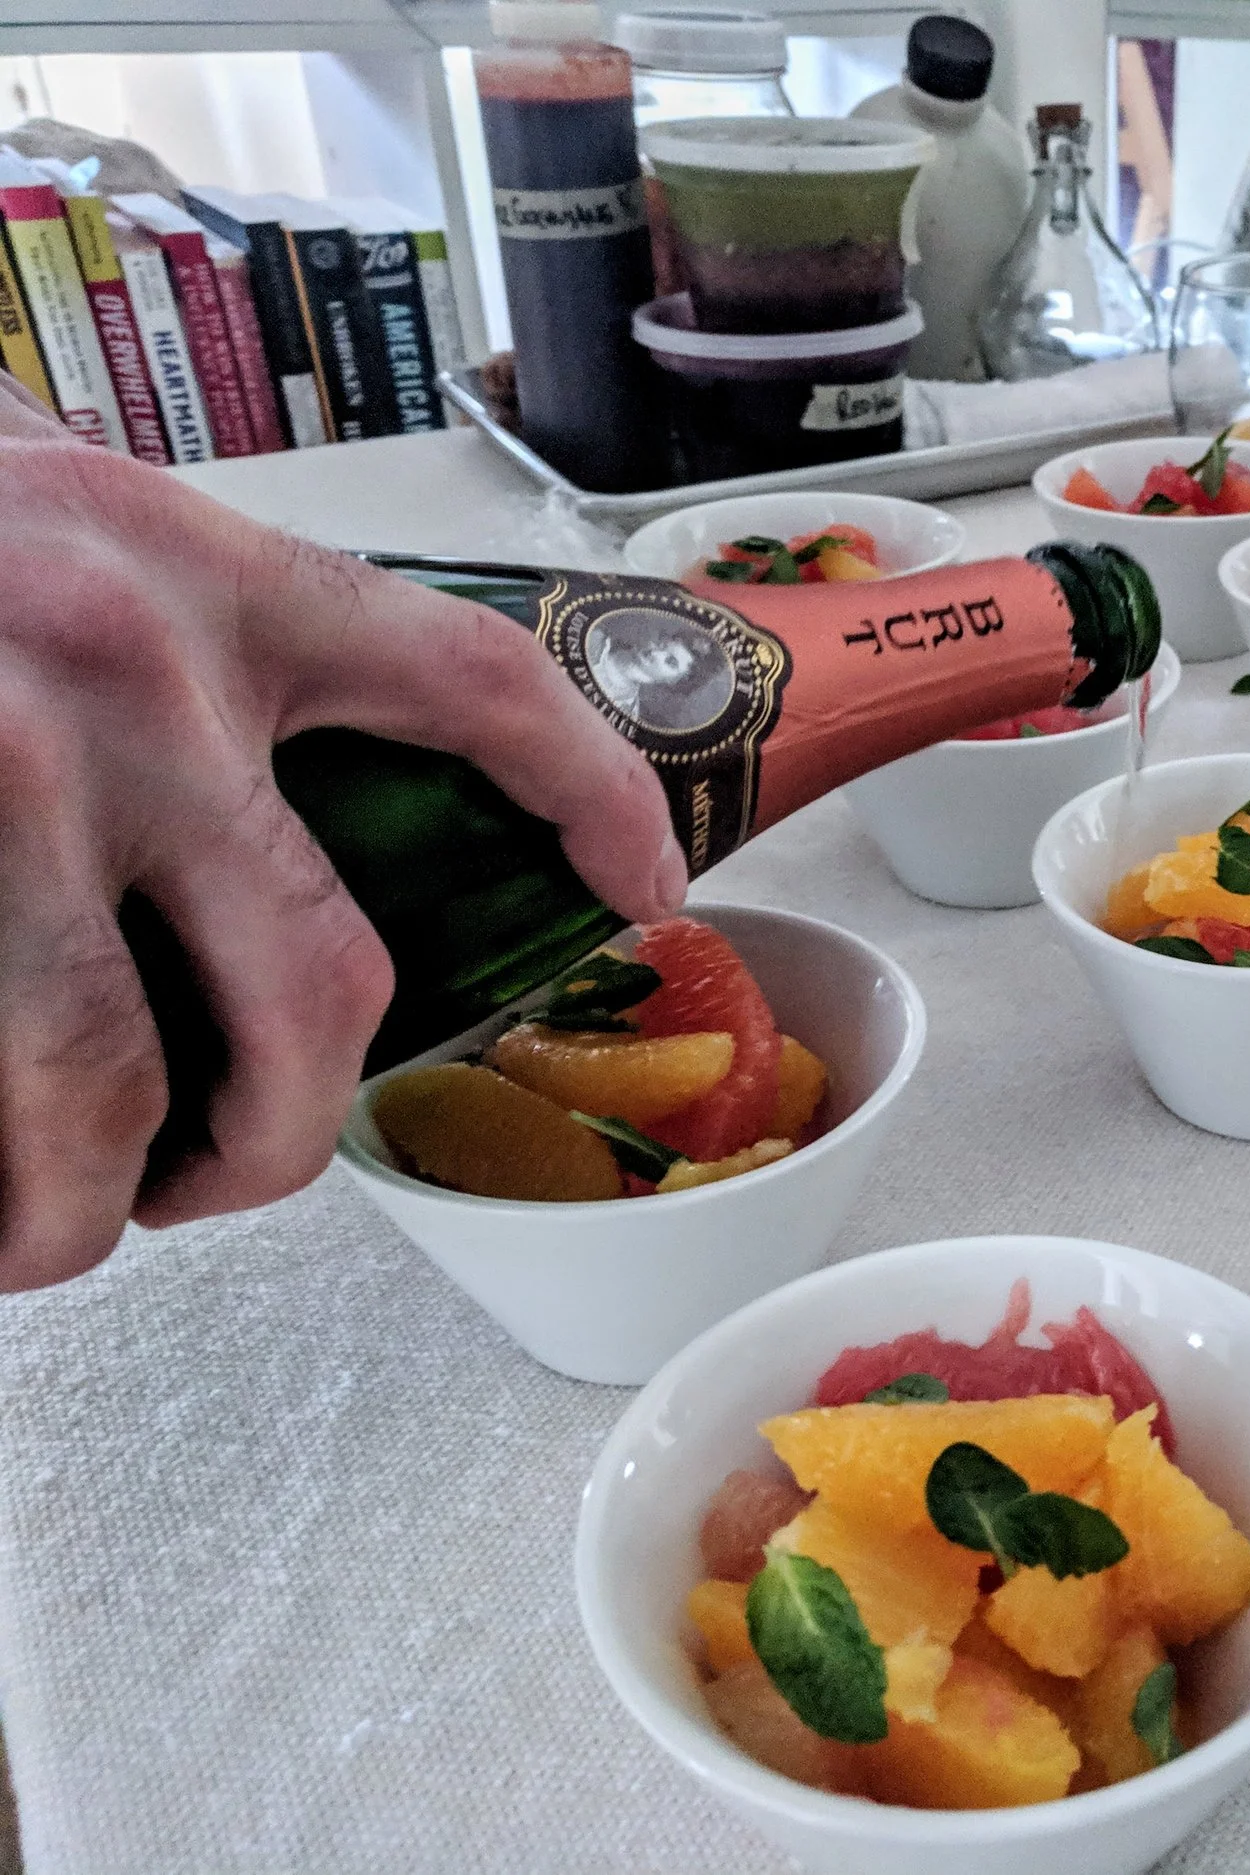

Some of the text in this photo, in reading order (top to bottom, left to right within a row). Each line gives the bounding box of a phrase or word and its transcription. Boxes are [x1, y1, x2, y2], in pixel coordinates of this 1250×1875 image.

[153, 331, 205, 463] HEARTMATH
[711, 619, 754, 698] BRUT
[843, 596, 1004, 655] BRUT
[691, 779, 714, 869] MÉTHOD
